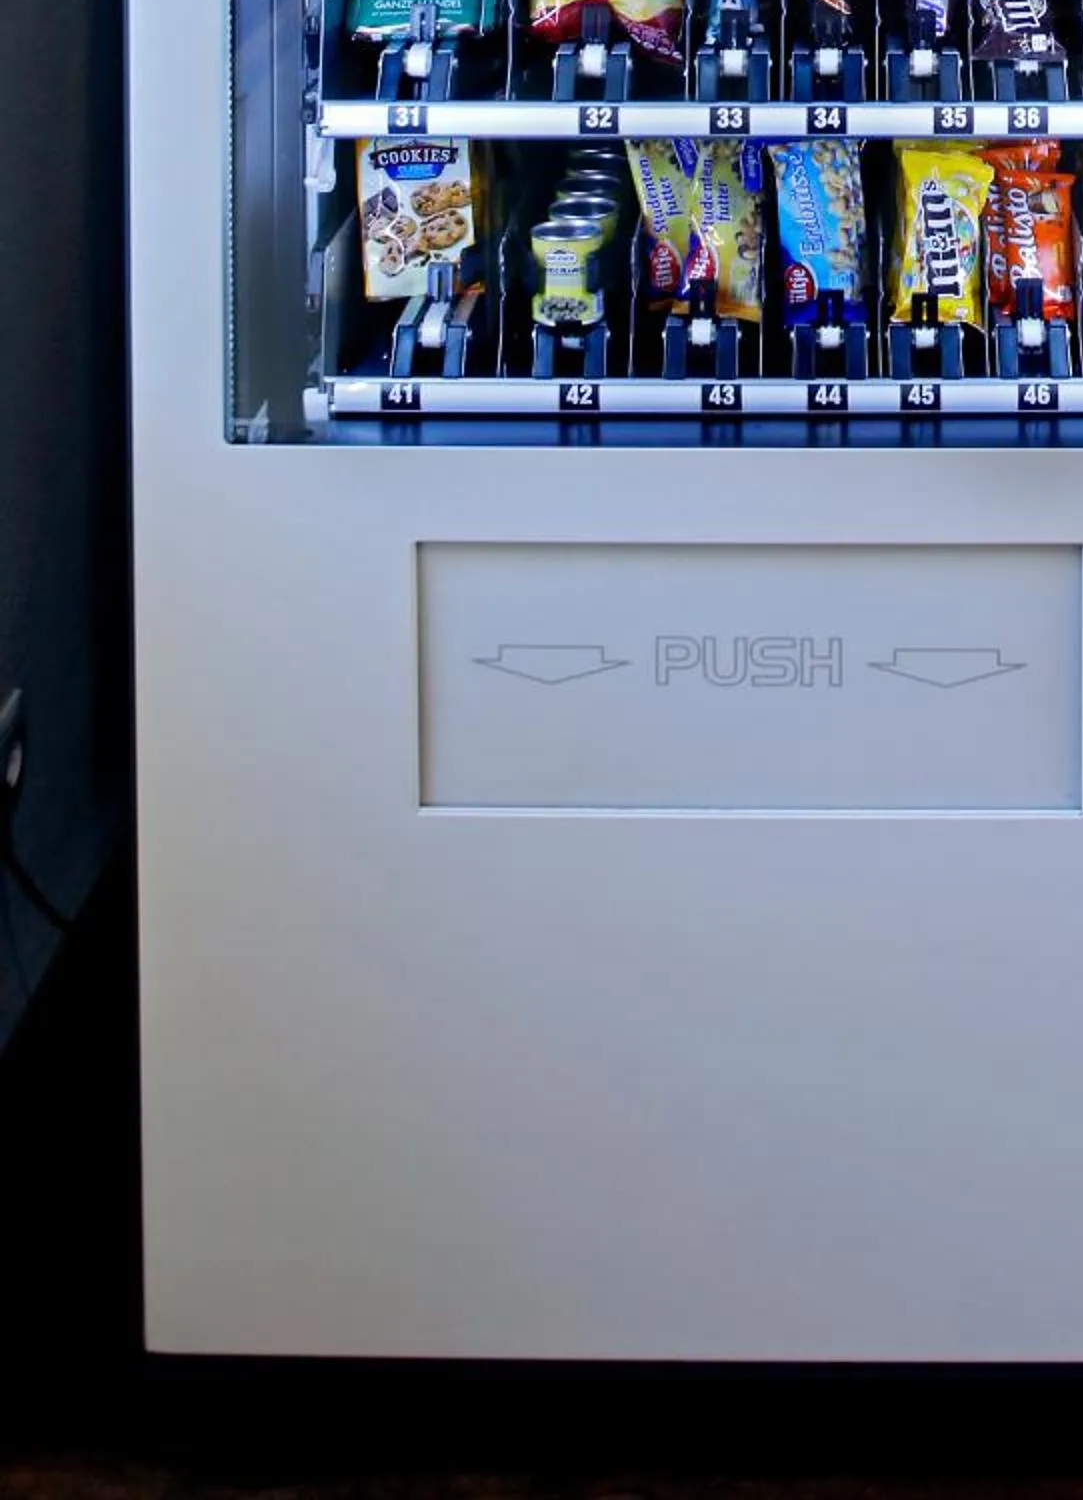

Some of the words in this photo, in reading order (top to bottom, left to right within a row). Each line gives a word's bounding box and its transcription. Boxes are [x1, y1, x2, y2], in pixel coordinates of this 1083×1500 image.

[396, 107, 419, 126] 31
[586, 108, 612, 128] 32
[717, 108, 743, 128] 33
[814, 108, 840, 128] 34
[941, 108, 966, 128] 35
[1013, 108, 1040, 128] 36
[377, 148, 451, 166] COOKIES
[639, 158, 669, 235] Studenten
[660, 175, 683, 217] futter
[716, 180, 732, 222] futter
[789, 153, 824, 257] Erdnüsse
[1006, 187, 1043, 287] Balisto
[787, 268, 810, 304] ültje
[388, 384, 413, 402] 41
[566, 385, 592, 404] 42
[709, 385, 735, 405] 43
[815, 385, 841, 405] 44
[909, 385, 934, 404] 45
[1024, 385, 1050, 404] 46
[655, 636, 843, 687] PUSH
